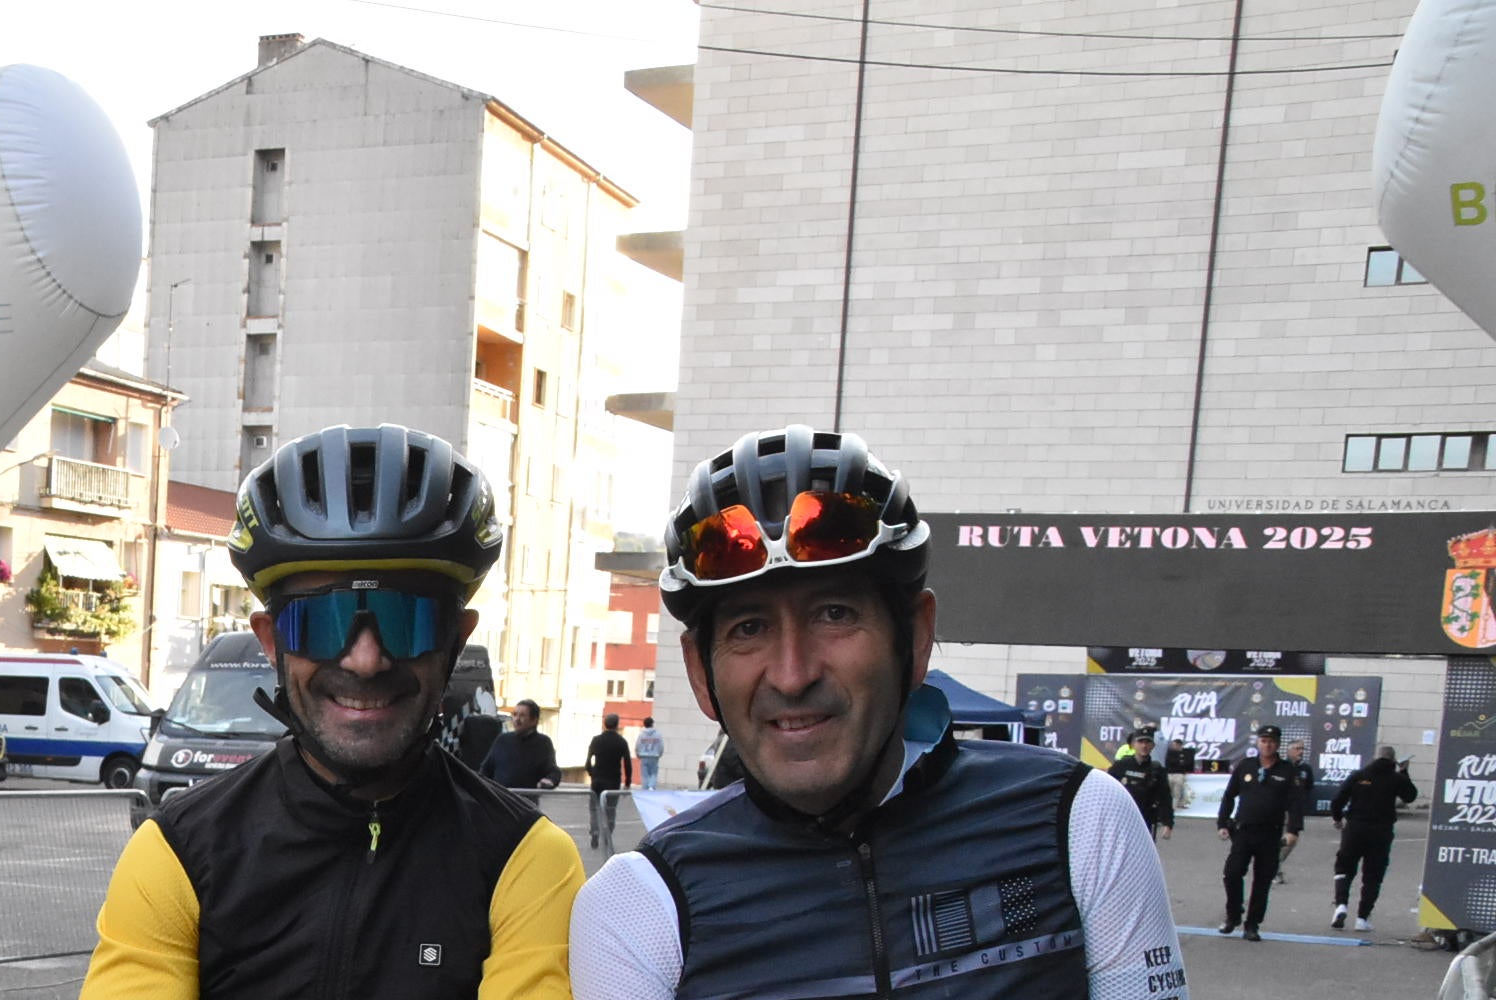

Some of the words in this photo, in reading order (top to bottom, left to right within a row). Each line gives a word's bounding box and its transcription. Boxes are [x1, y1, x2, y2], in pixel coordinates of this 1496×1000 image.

[1207, 499, 1314, 511] UNIVERSIDAD
[1320, 499, 1340, 511] DE
[1346, 499, 1451, 511] SALAMANCA
[957, 525, 1065, 548] RUTA
[1080, 525, 1248, 548] VETONA
[1262, 525, 1374, 550] 2025
[1172, 691, 1218, 717] RUTA
[1275, 701, 1311, 716] TRAIL
[1100, 726, 1123, 741] BTT
[1160, 717, 1236, 743] VETONA
[915, 960, 958, 980] THE
[981, 934, 1072, 965] CUSTOM
[1144, 946, 1171, 968] KEEP
